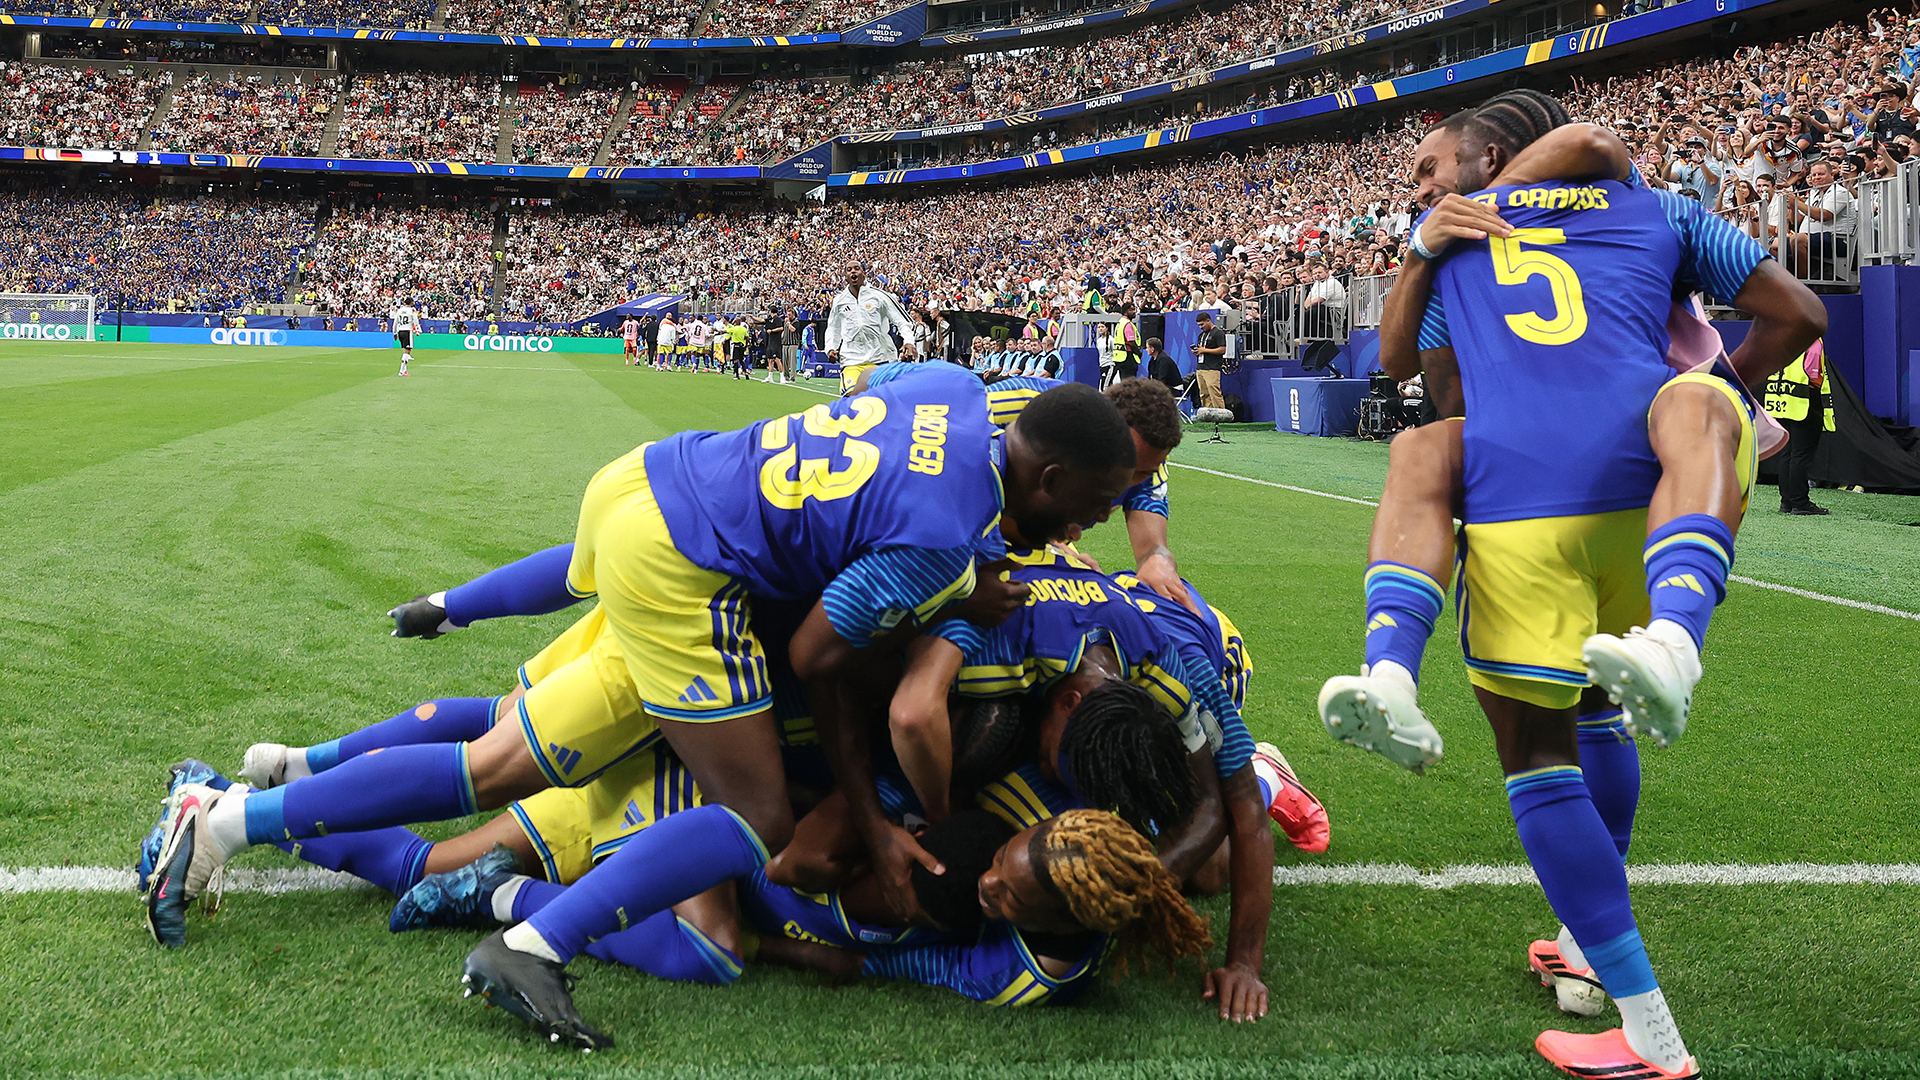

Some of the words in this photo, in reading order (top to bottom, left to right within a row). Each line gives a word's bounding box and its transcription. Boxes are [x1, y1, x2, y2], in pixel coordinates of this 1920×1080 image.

[1020, 27, 1033, 36] FIFA
[1033, 24, 1053, 34] WORLD
[1053, 21, 1065, 31] CUP
[1064, 17, 1084, 28] 2026
[1387, 8, 1444, 34] HOUSTON
[865, 28, 889, 37] WORLD
[889, 29, 903, 37] CUP
[1569, 37, 1577, 51] G
[1446, 68, 1453, 82] G
[1085, 94, 1123, 110] HOUSTON
[1250, 113, 1257, 125] G
[921, 130, 933, 138] FIFA
[932, 127, 953, 137] WORLD
[952, 125, 964, 134] CUP
[963, 123, 984, 132] 2026
[793, 162, 814, 170] WORLD
[1488, 227, 1589, 347] 5
[463, 335, 554, 353] aramco
